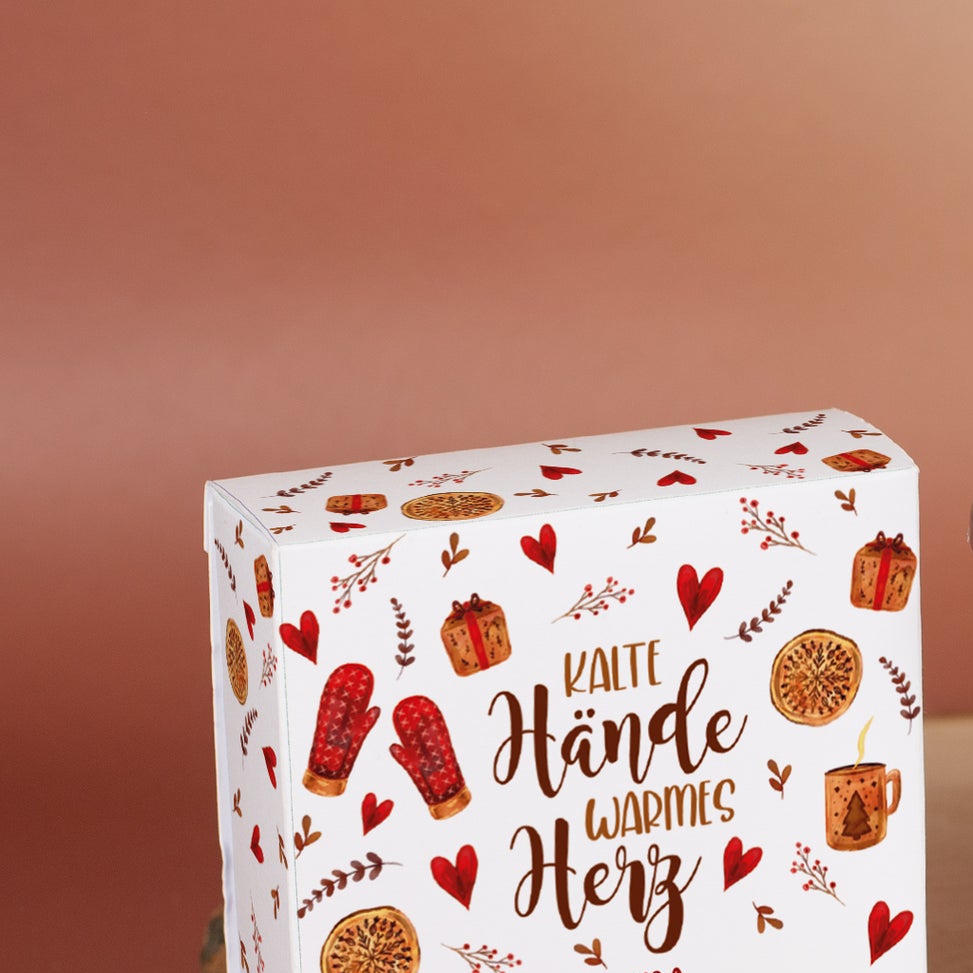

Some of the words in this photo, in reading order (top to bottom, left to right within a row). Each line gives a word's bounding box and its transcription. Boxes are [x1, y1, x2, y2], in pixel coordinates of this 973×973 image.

[564, 640, 662, 698] KALTE
[488, 657, 749, 799] Hände
[585, 778, 736, 842] WARMES
[510, 817, 703, 955] Herz
